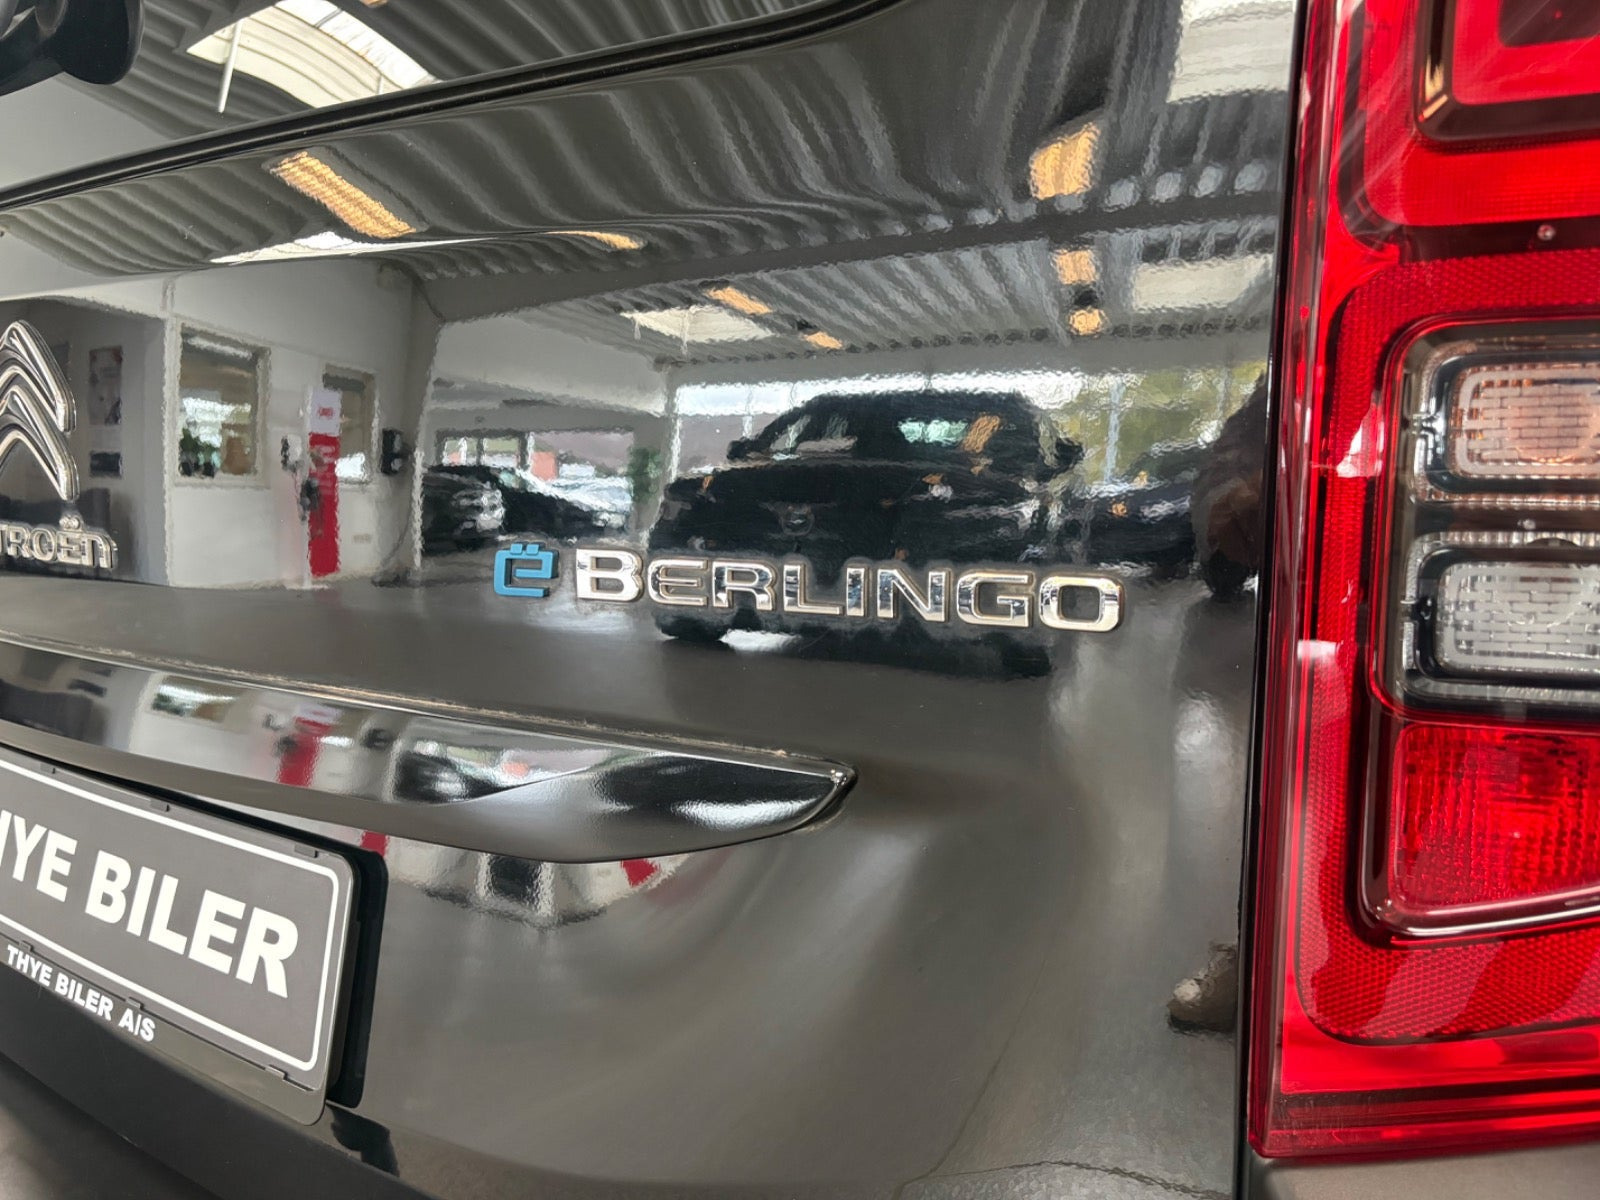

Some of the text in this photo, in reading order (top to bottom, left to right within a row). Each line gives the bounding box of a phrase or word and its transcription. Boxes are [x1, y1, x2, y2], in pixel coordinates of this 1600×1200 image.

[576, 548, 1123, 633] BERLINGO
[85, 850, 299, 998] BILER
[7, 944, 53, 987] THYE
[55, 972, 114, 1021] BILER
